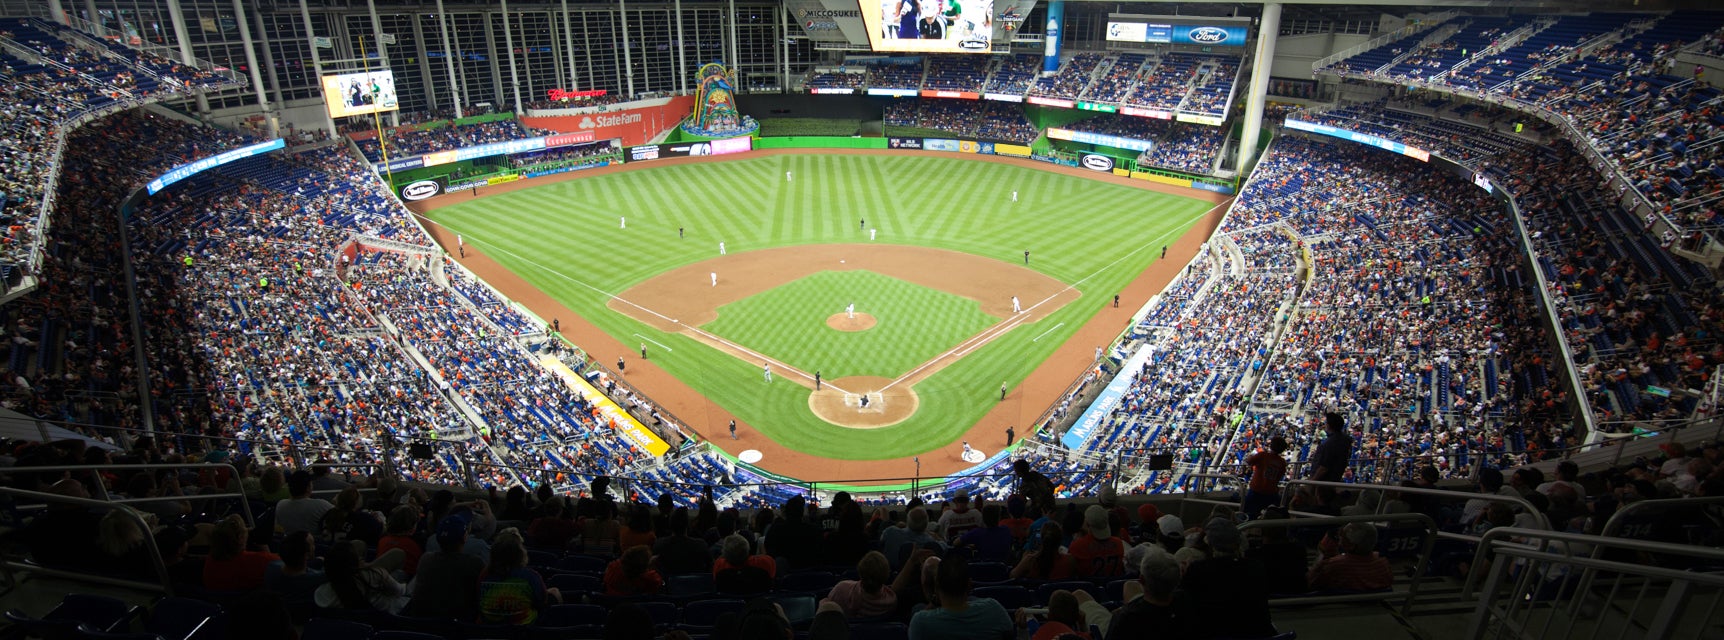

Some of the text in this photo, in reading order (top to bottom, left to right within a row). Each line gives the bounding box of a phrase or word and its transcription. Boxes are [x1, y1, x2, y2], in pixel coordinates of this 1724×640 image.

[1195, 29, 1220, 41] Ford
[546, 134, 593, 147] CLEVELANDER
[1099, 395, 1116, 412] PARK
[1389, 536, 1420, 551] 315
